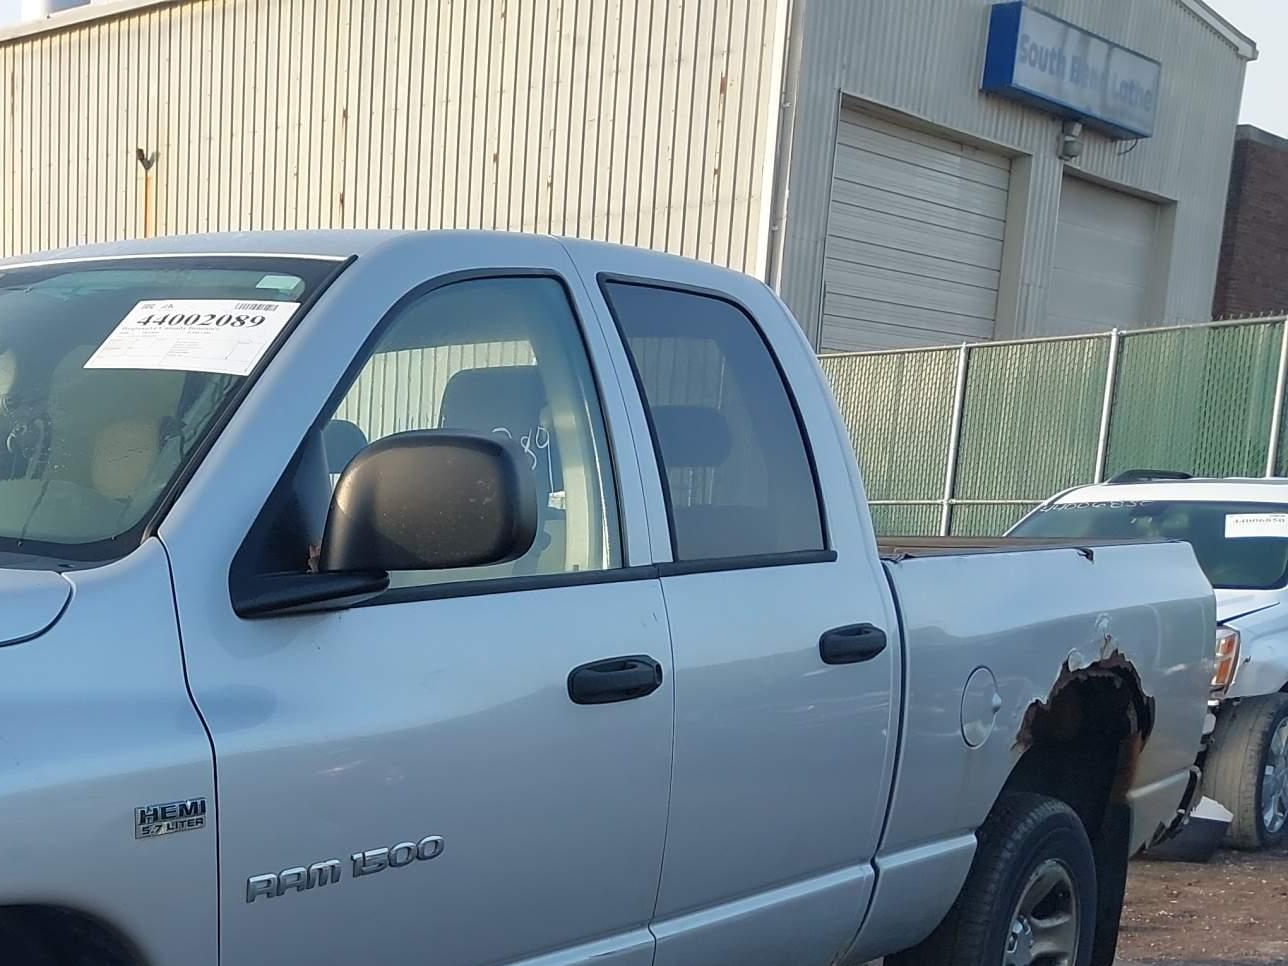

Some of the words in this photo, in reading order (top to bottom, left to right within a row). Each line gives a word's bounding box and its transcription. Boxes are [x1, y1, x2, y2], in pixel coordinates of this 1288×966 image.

[1018, 33, 1065, 81] South
[137, 313, 266, 328] 44002089
[139, 799, 207, 825] HEMI
[142, 825, 163, 835] 5.7
[167, 817, 204, 831] LITER
[246, 859, 342, 904] RAM
[351, 835, 444, 878] 1500
